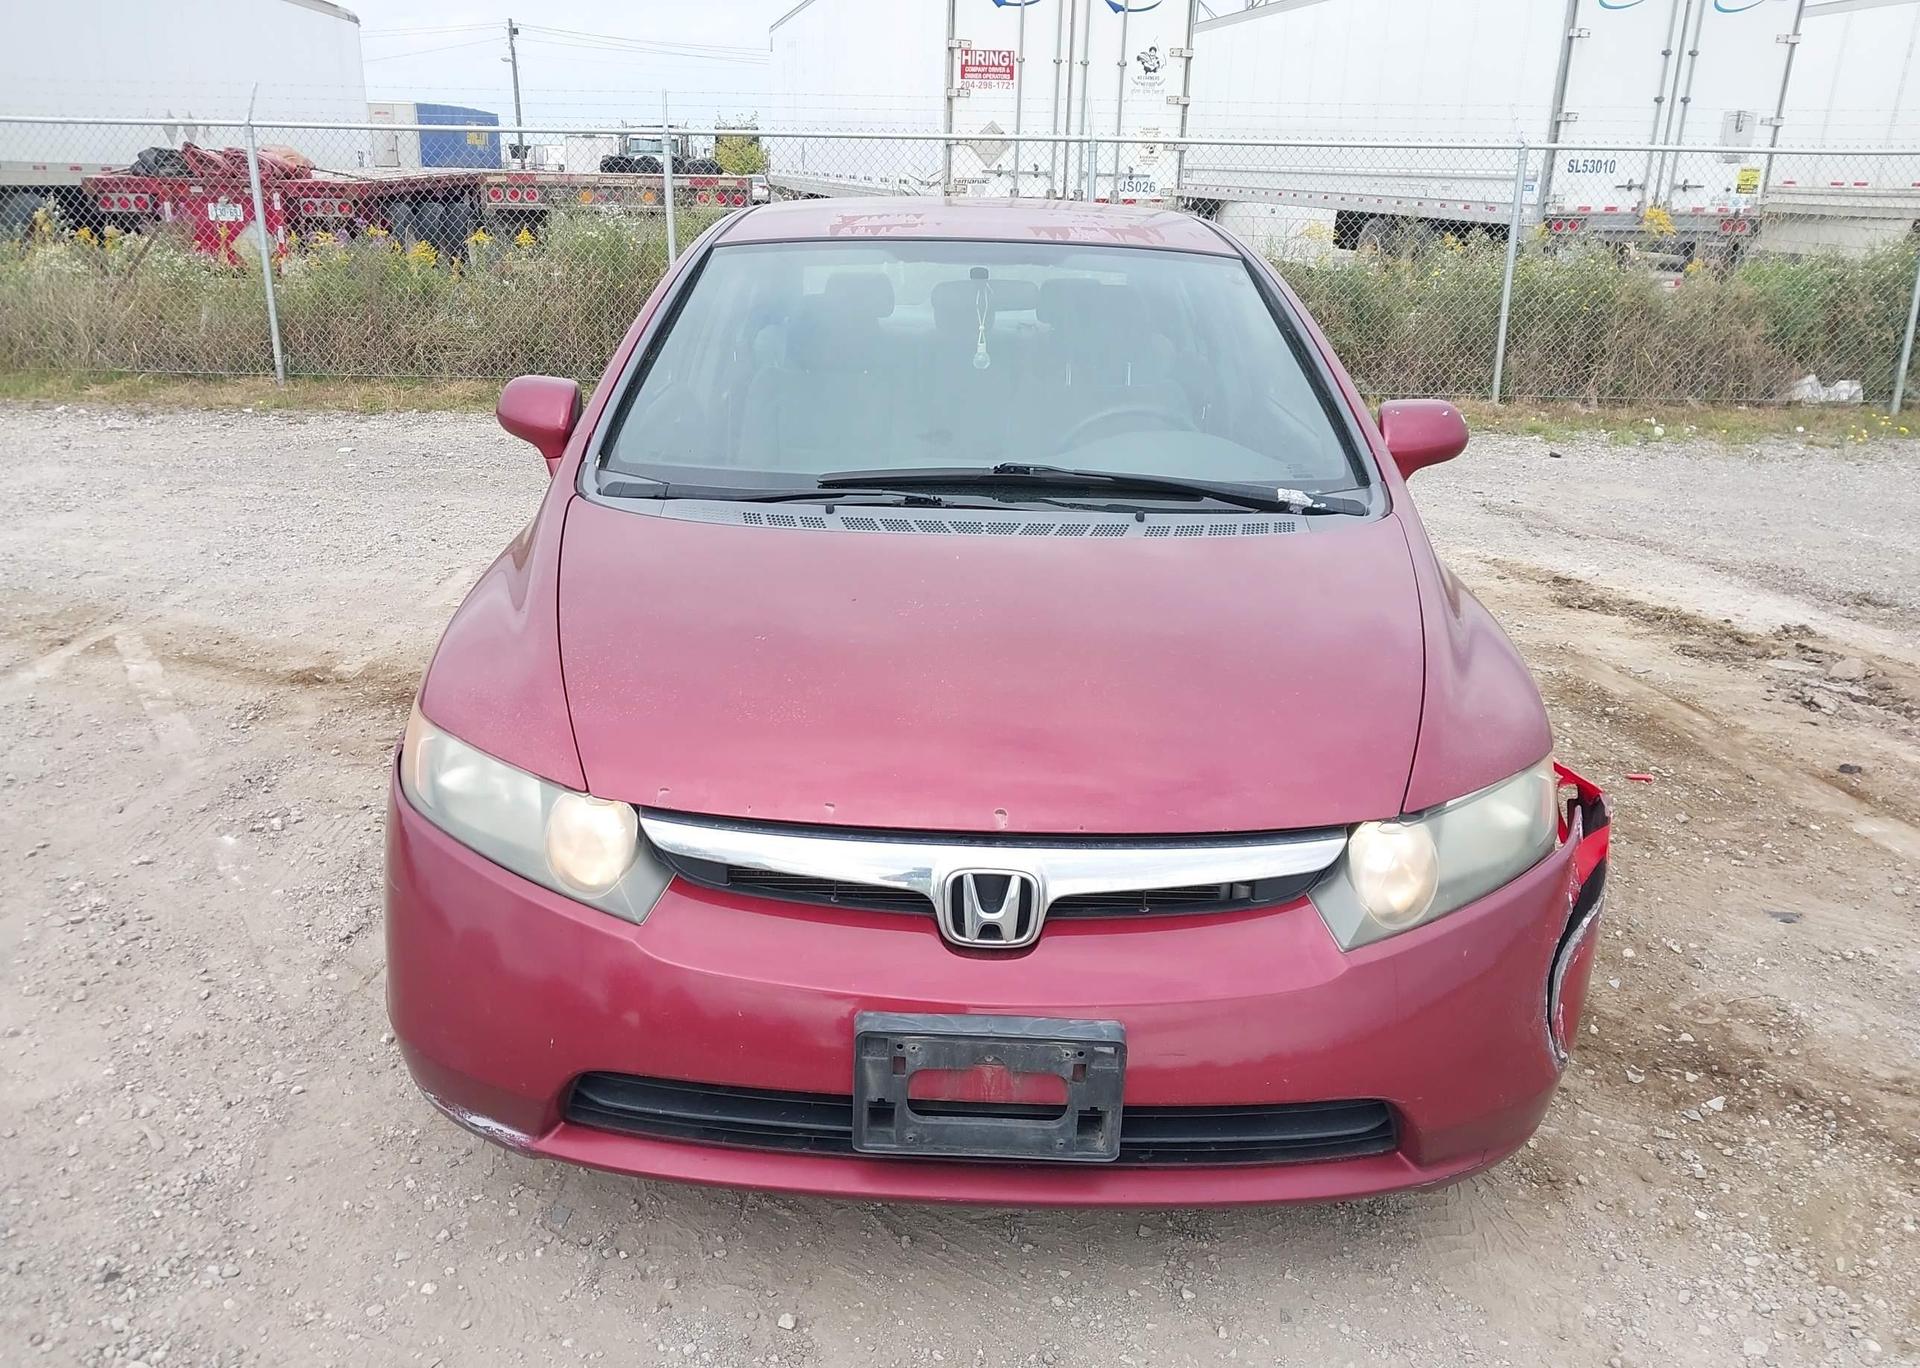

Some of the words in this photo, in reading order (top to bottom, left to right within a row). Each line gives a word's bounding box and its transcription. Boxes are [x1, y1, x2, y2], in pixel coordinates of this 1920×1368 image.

[962, 51, 1013, 66] HIRING!
[960, 81, 1014, 89] 204-298-1721
[1567, 159, 1616, 173] SL53010
[1119, 180, 1156, 192] JS026
